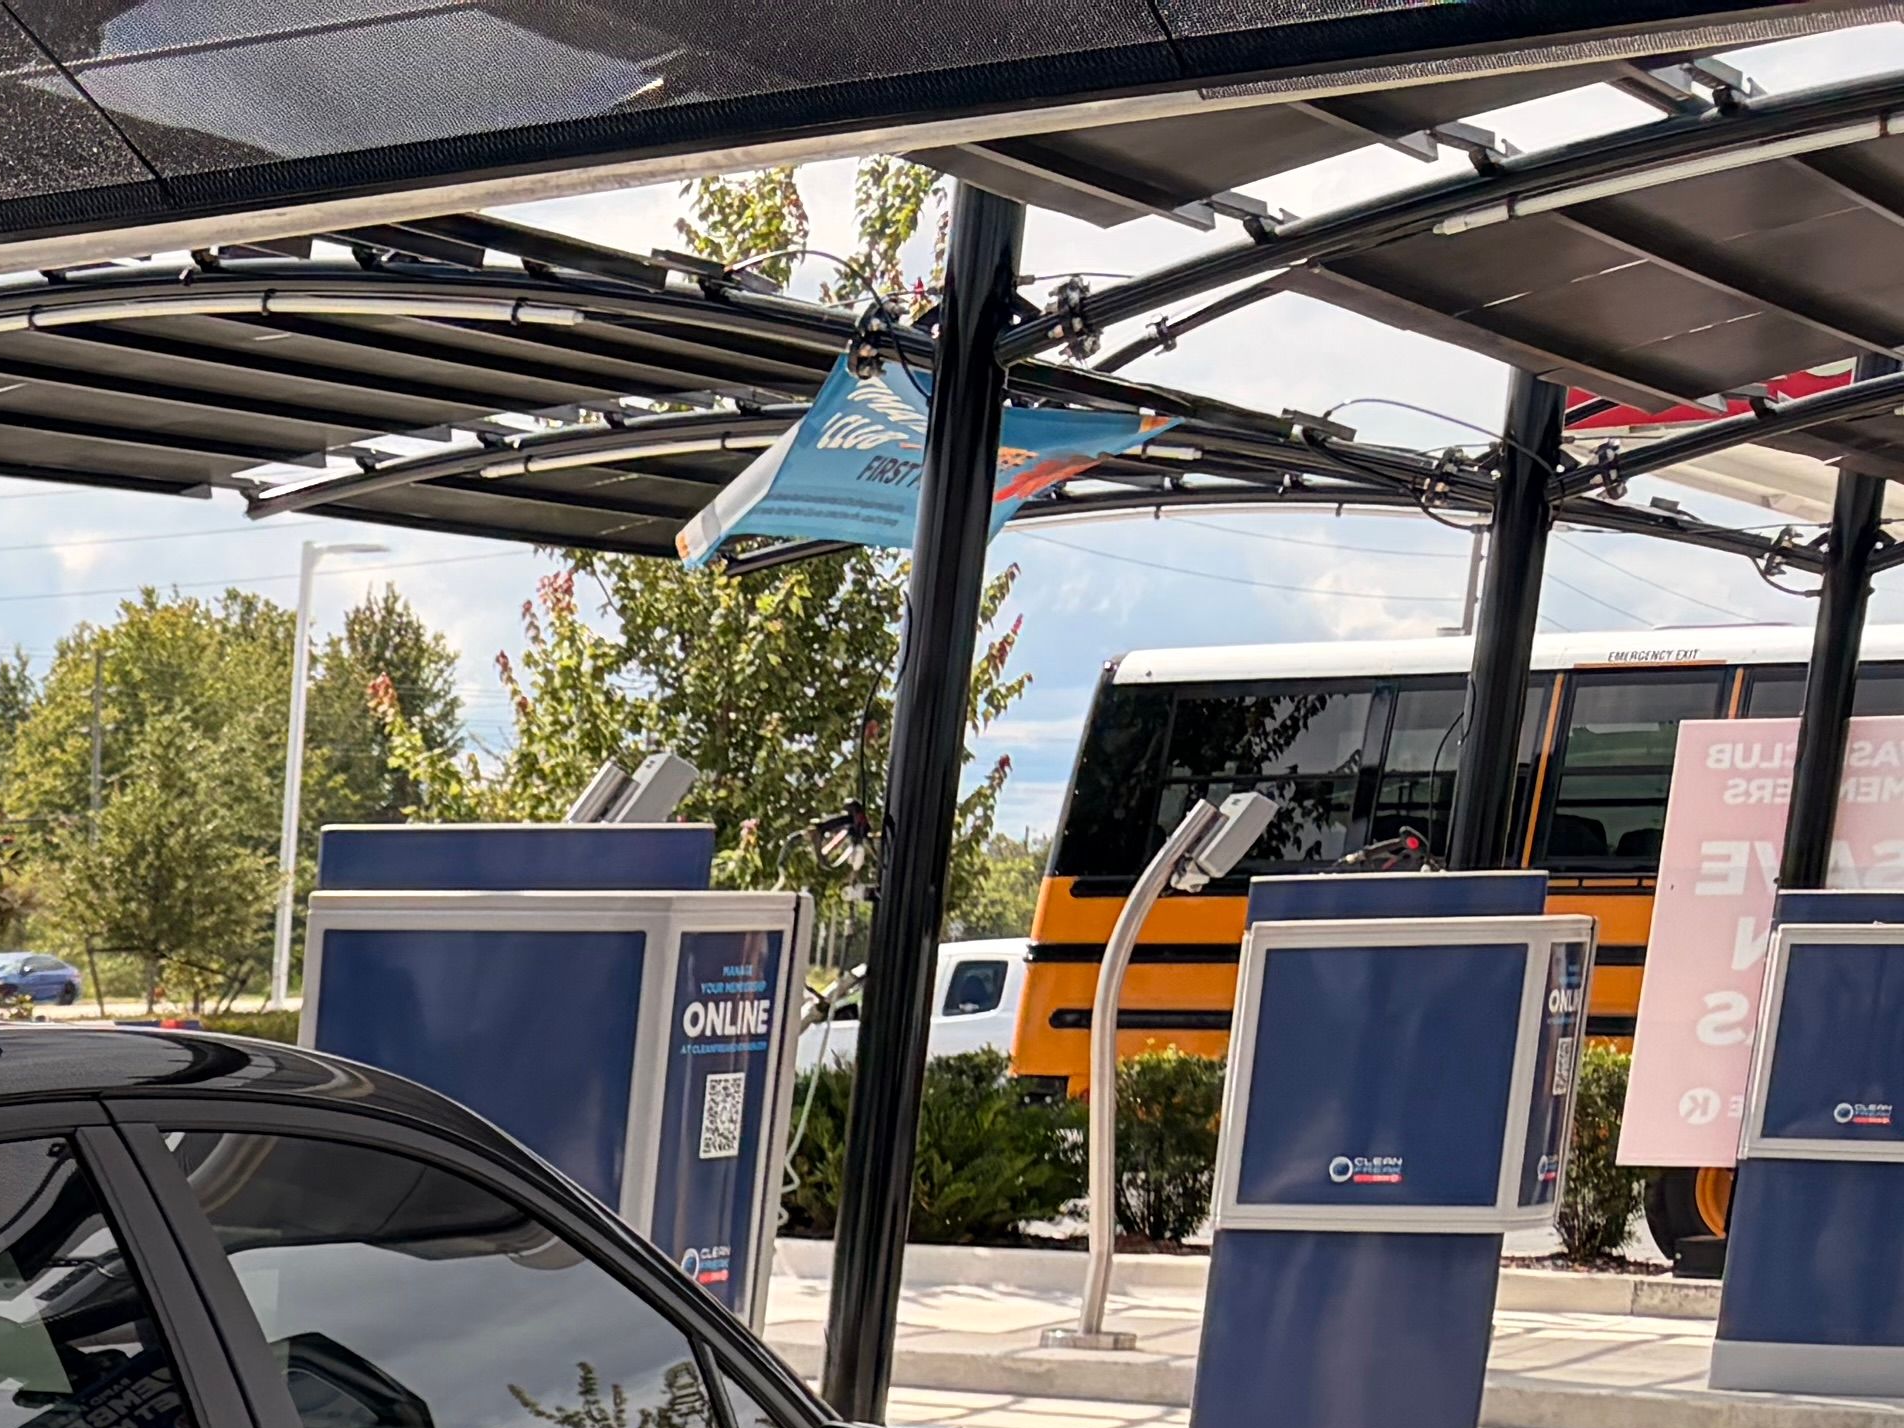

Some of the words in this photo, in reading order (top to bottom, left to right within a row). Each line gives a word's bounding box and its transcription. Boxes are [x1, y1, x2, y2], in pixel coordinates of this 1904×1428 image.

[1608, 650, 1673, 662] EMERGENCY
[1675, 649, 1700, 661] EXIT
[683, 999, 770, 1038] ONLINE
